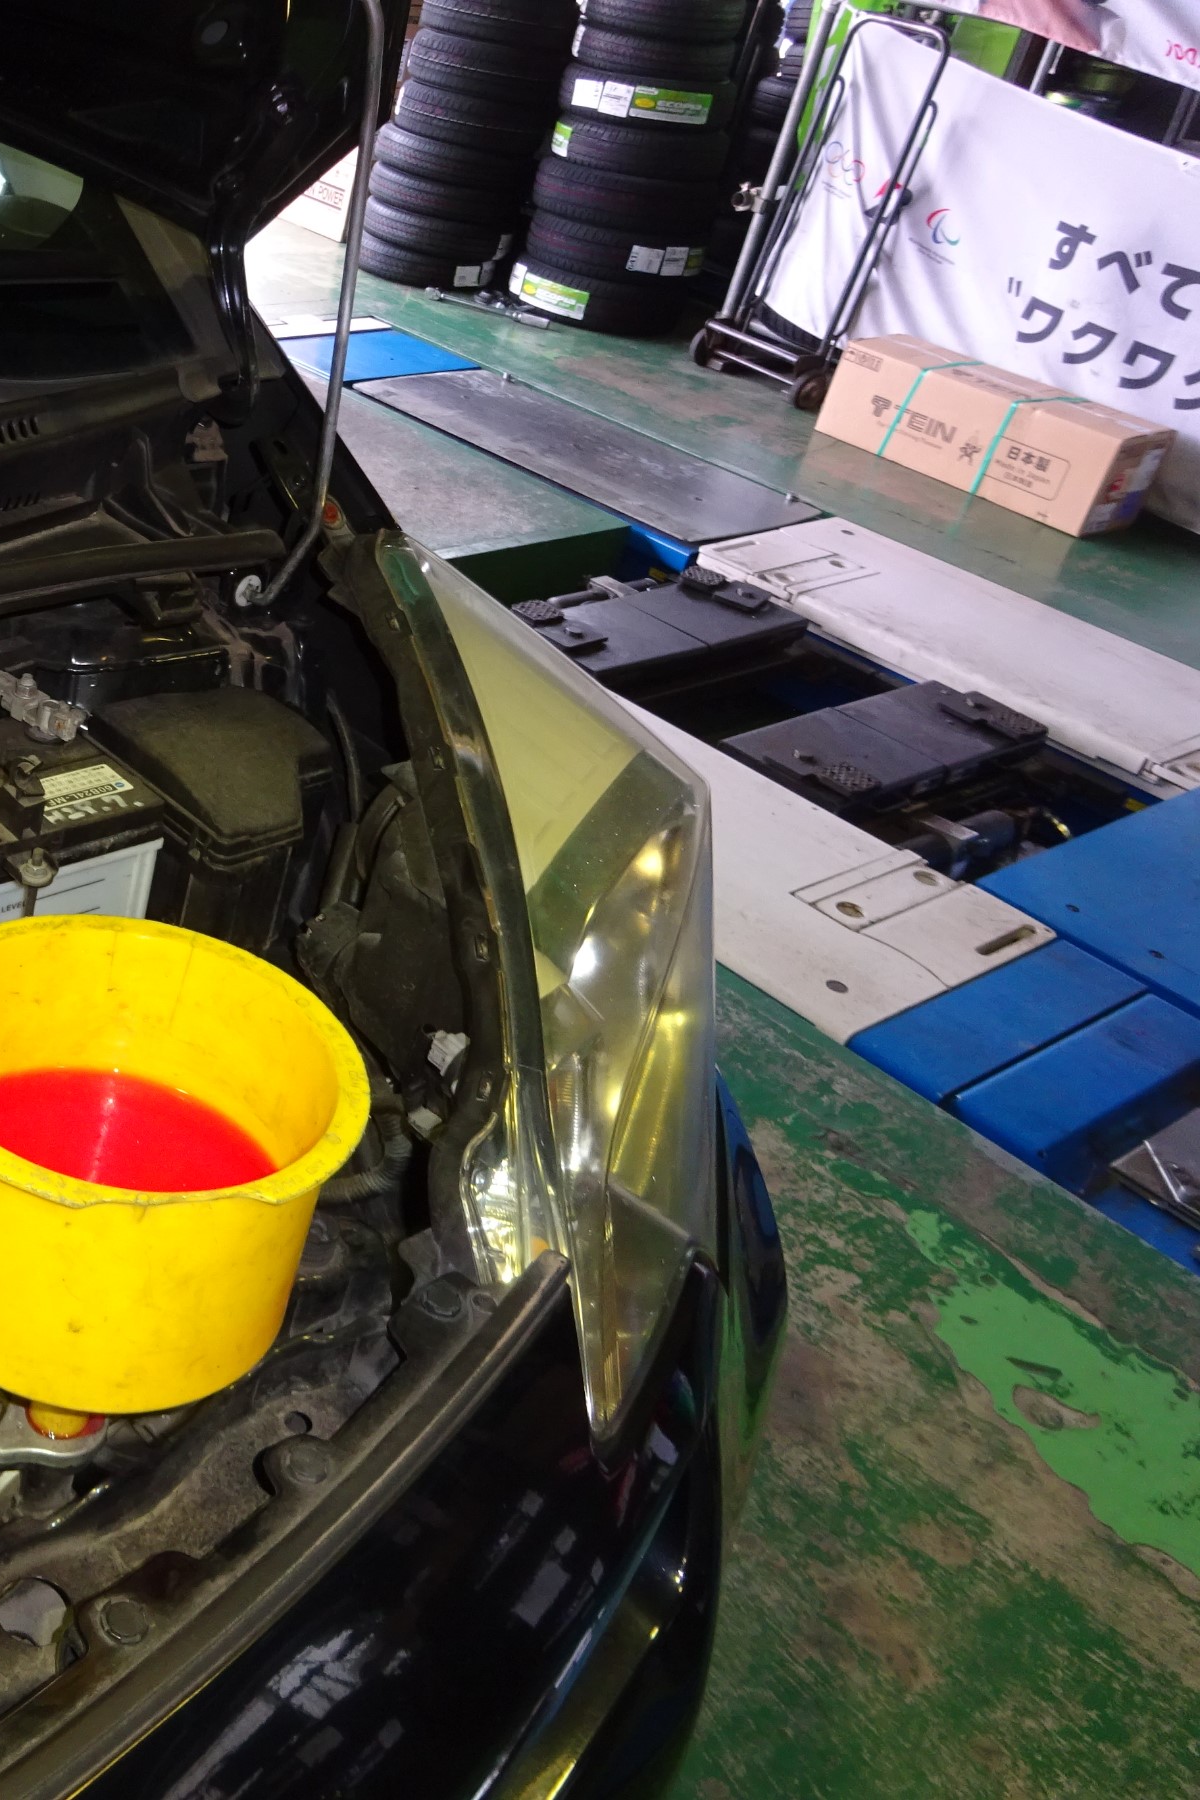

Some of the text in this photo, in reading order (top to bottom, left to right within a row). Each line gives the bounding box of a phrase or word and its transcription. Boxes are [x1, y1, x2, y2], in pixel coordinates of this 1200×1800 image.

[318, 185, 345, 206] POWER
[1049, 220, 1200, 321] すべて
[1007, 446, 1052, 473] 日本製
